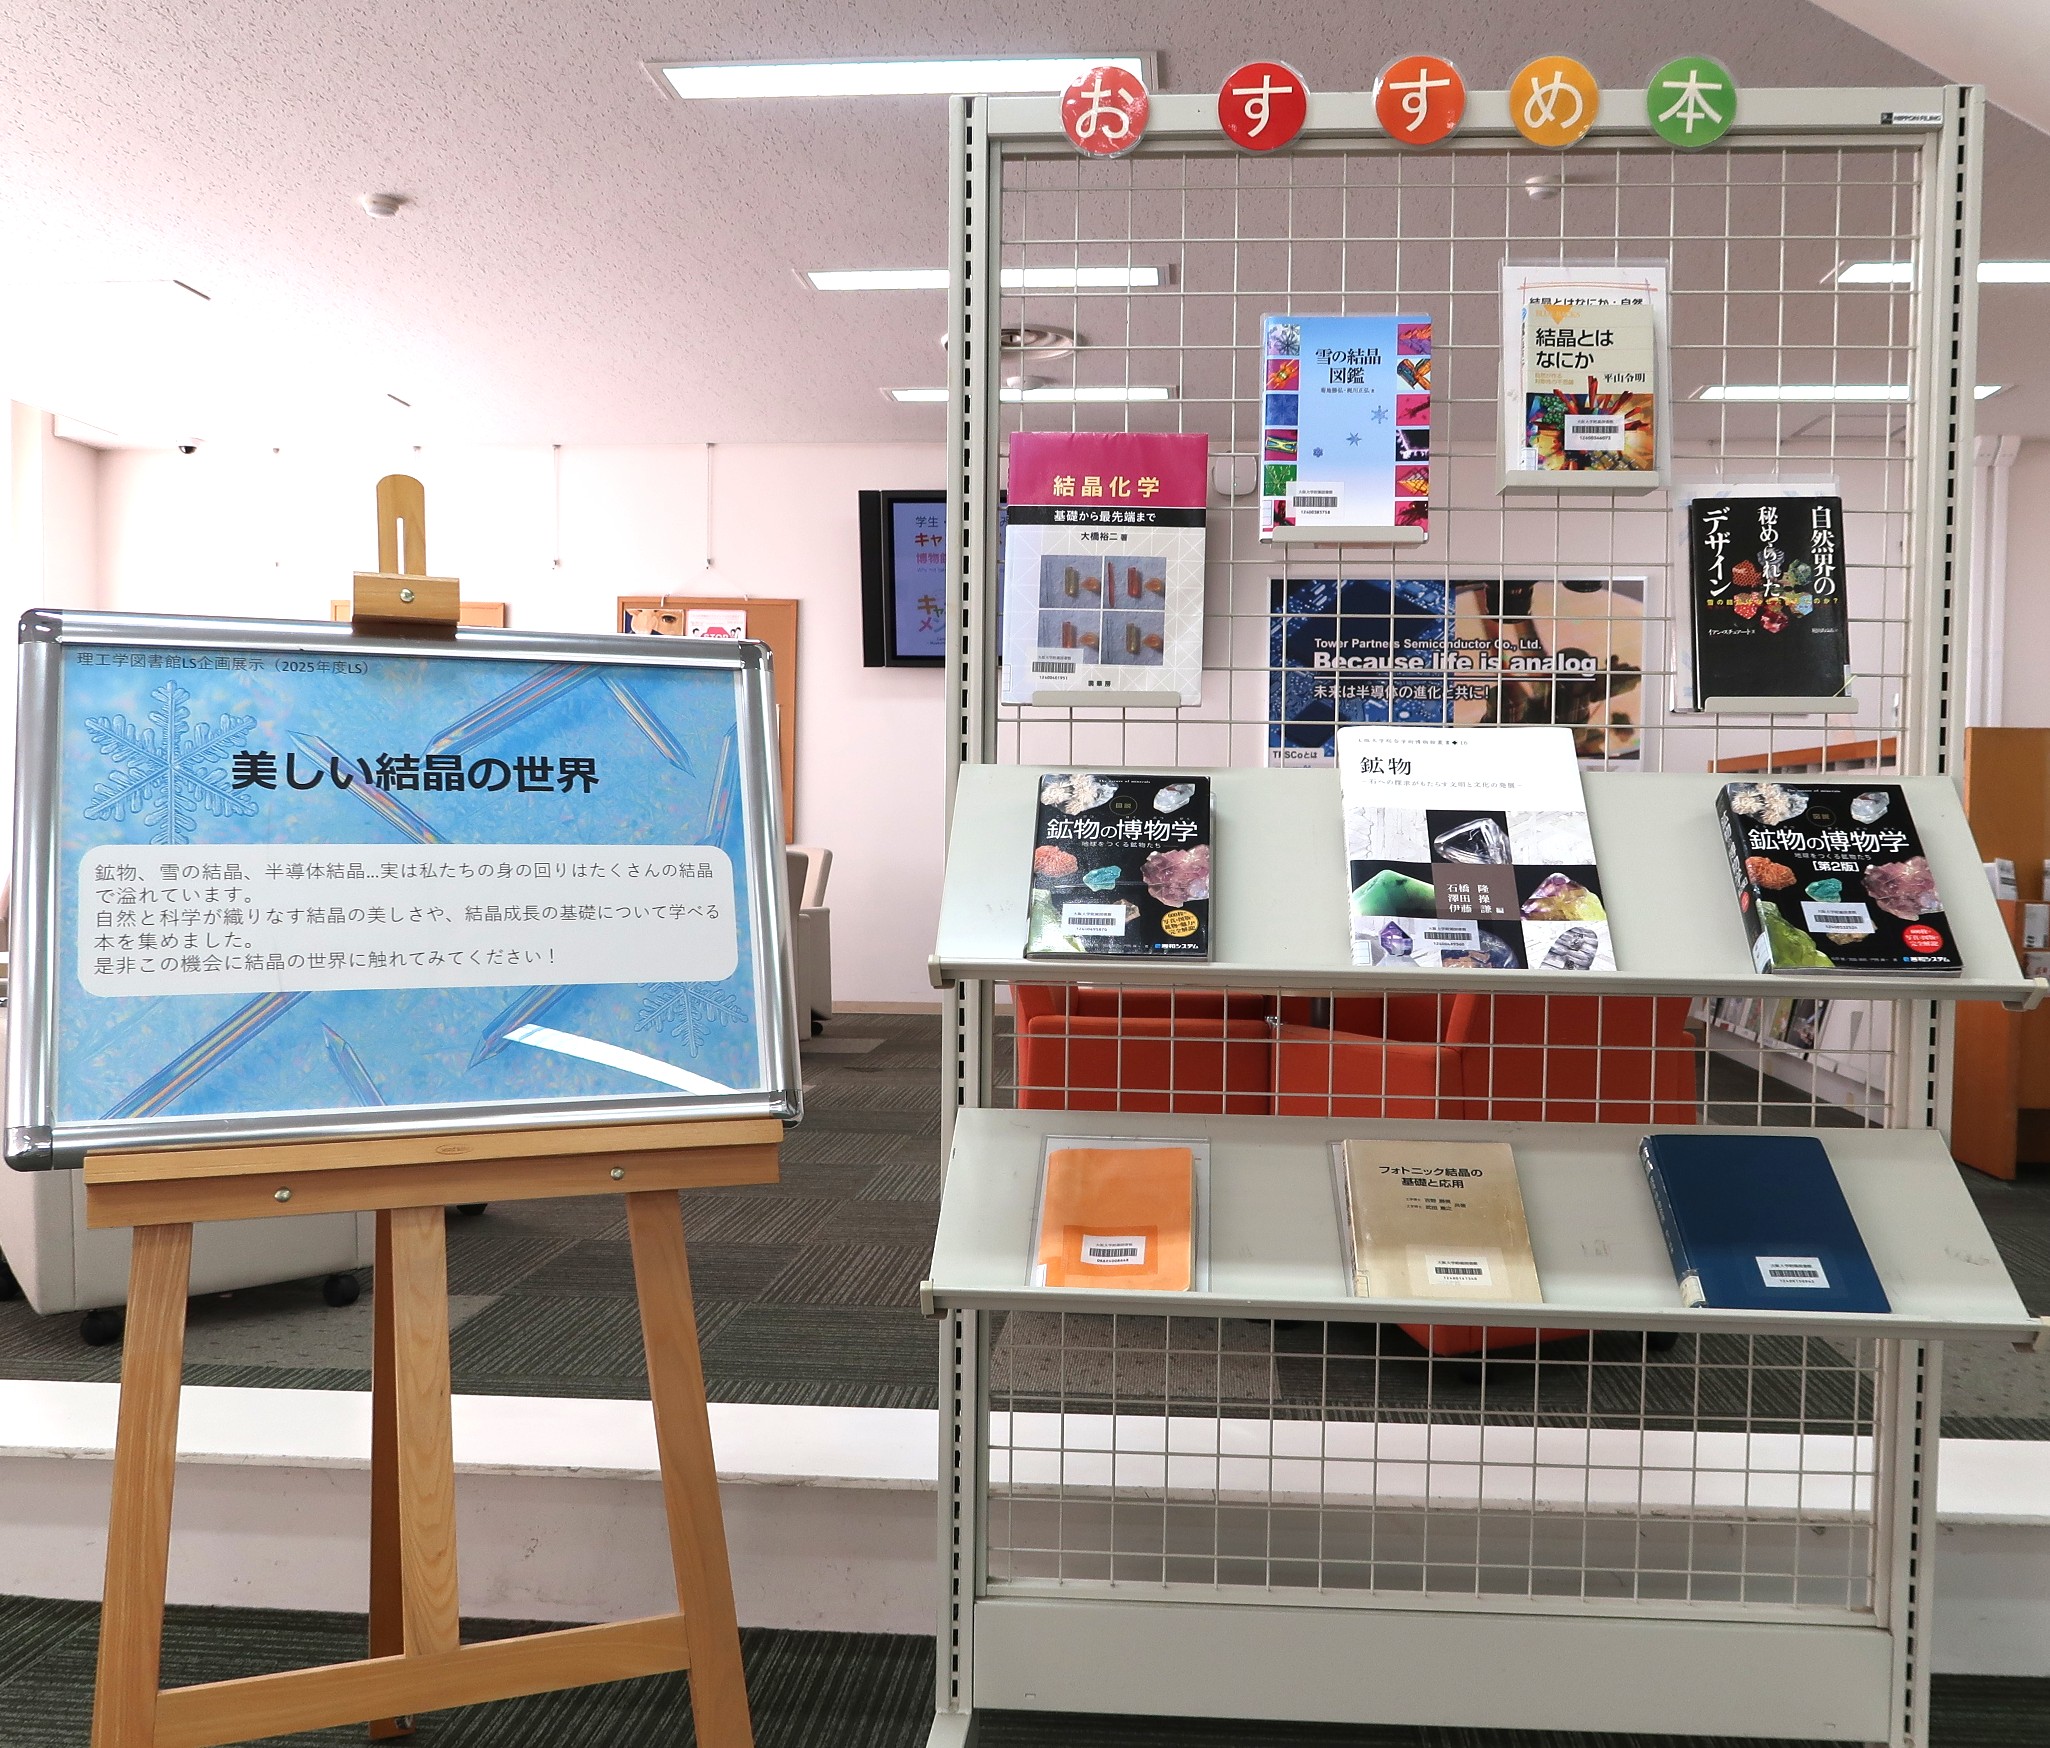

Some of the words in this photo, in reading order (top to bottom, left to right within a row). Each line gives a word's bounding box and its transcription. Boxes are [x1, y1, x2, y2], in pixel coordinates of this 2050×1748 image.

[1535, 328, 1614, 348] 結晶とは
[1315, 348, 1381, 366] 雪の結晶
[1536, 351, 1594, 369] なにか
[1330, 367, 1365, 384] 図鑑
[1604, 373, 1646, 383] 平山令明
[1053, 475, 1160, 498] 結晶化学
[1054, 510, 1156, 523] 基礎から最先端まで
[1081, 531, 1118, 541] 大橋裕二
[1702, 506, 1732, 597] デザイン
[1758, 505, 1780, 598] 秘められた
[1811, 505, 1836, 596] 自然界の
[1520, 639, 1542, 650] Ltd.
[1314, 651, 1424, 671] Because
[1433, 652, 1472, 671] life
[1480, 652, 1501, 671] is
[1510, 654, 1598, 677] analog
[232, 749, 600, 794] 美しい結晶の世界
[1360, 756, 1412, 776] 鉱物
[1046, 818, 1198, 842] 鉱物の博物学
[1081, 841, 1161, 849] 地球をつくる鉱物たち
[1748, 829, 1909, 853] 鉱物の博物学
[95, 886, 253, 905] で溢れています。
[1446, 884, 1470, 893] 石橋
[95, 903, 720, 928] 自然と科学が織りなす結晶の美しさや、結晶成長の基礎について学べる
[94, 931, 253, 951] 本を集めました。
[1379, 1166, 1483, 1178] フォトニック結晶の
[1401, 1178, 1465, 1189] 基礎と応用
